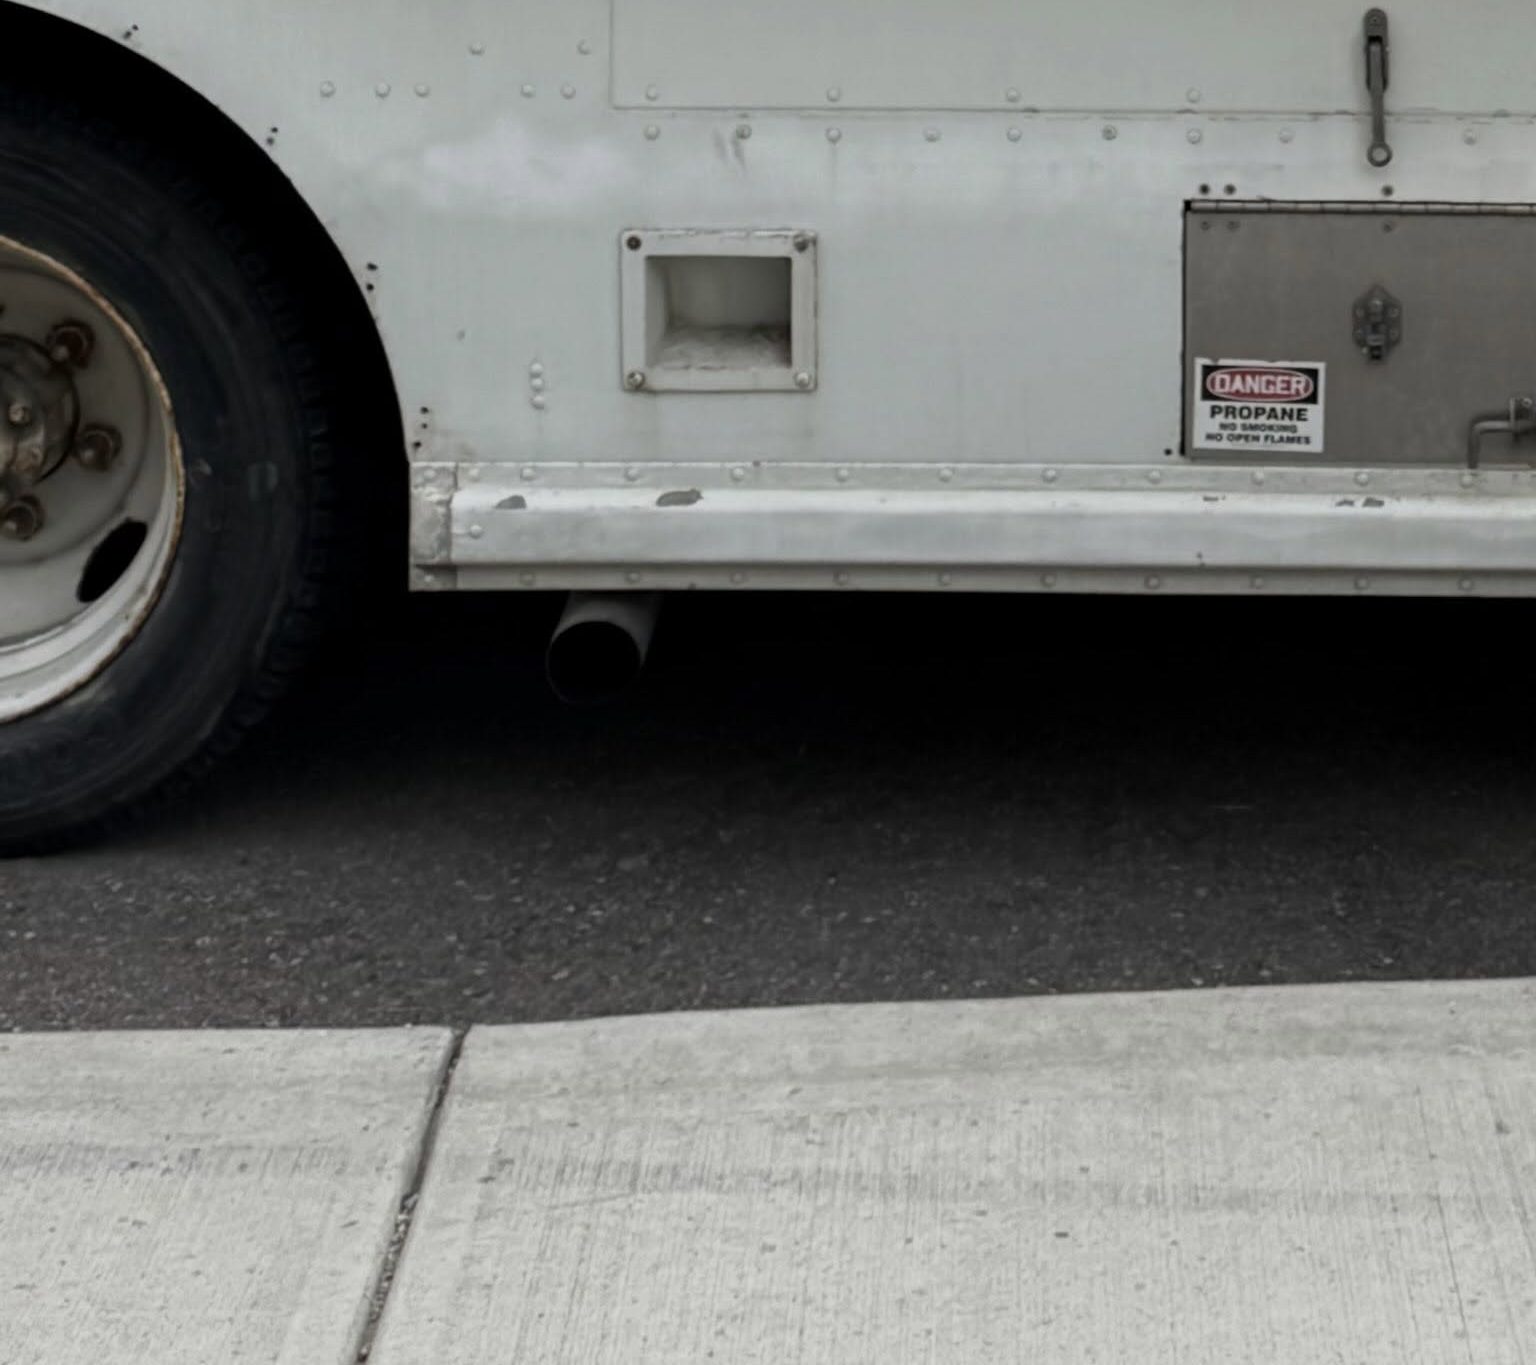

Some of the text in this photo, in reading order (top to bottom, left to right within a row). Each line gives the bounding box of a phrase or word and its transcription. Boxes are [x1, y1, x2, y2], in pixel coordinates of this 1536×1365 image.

[1214, 373, 1307, 395] DANGER
[1210, 405, 1309, 422] PROPANE
[1219, 422, 1298, 434] NO SMOKING
[1205, 433, 1312, 445] NO OPEN FLAMES
